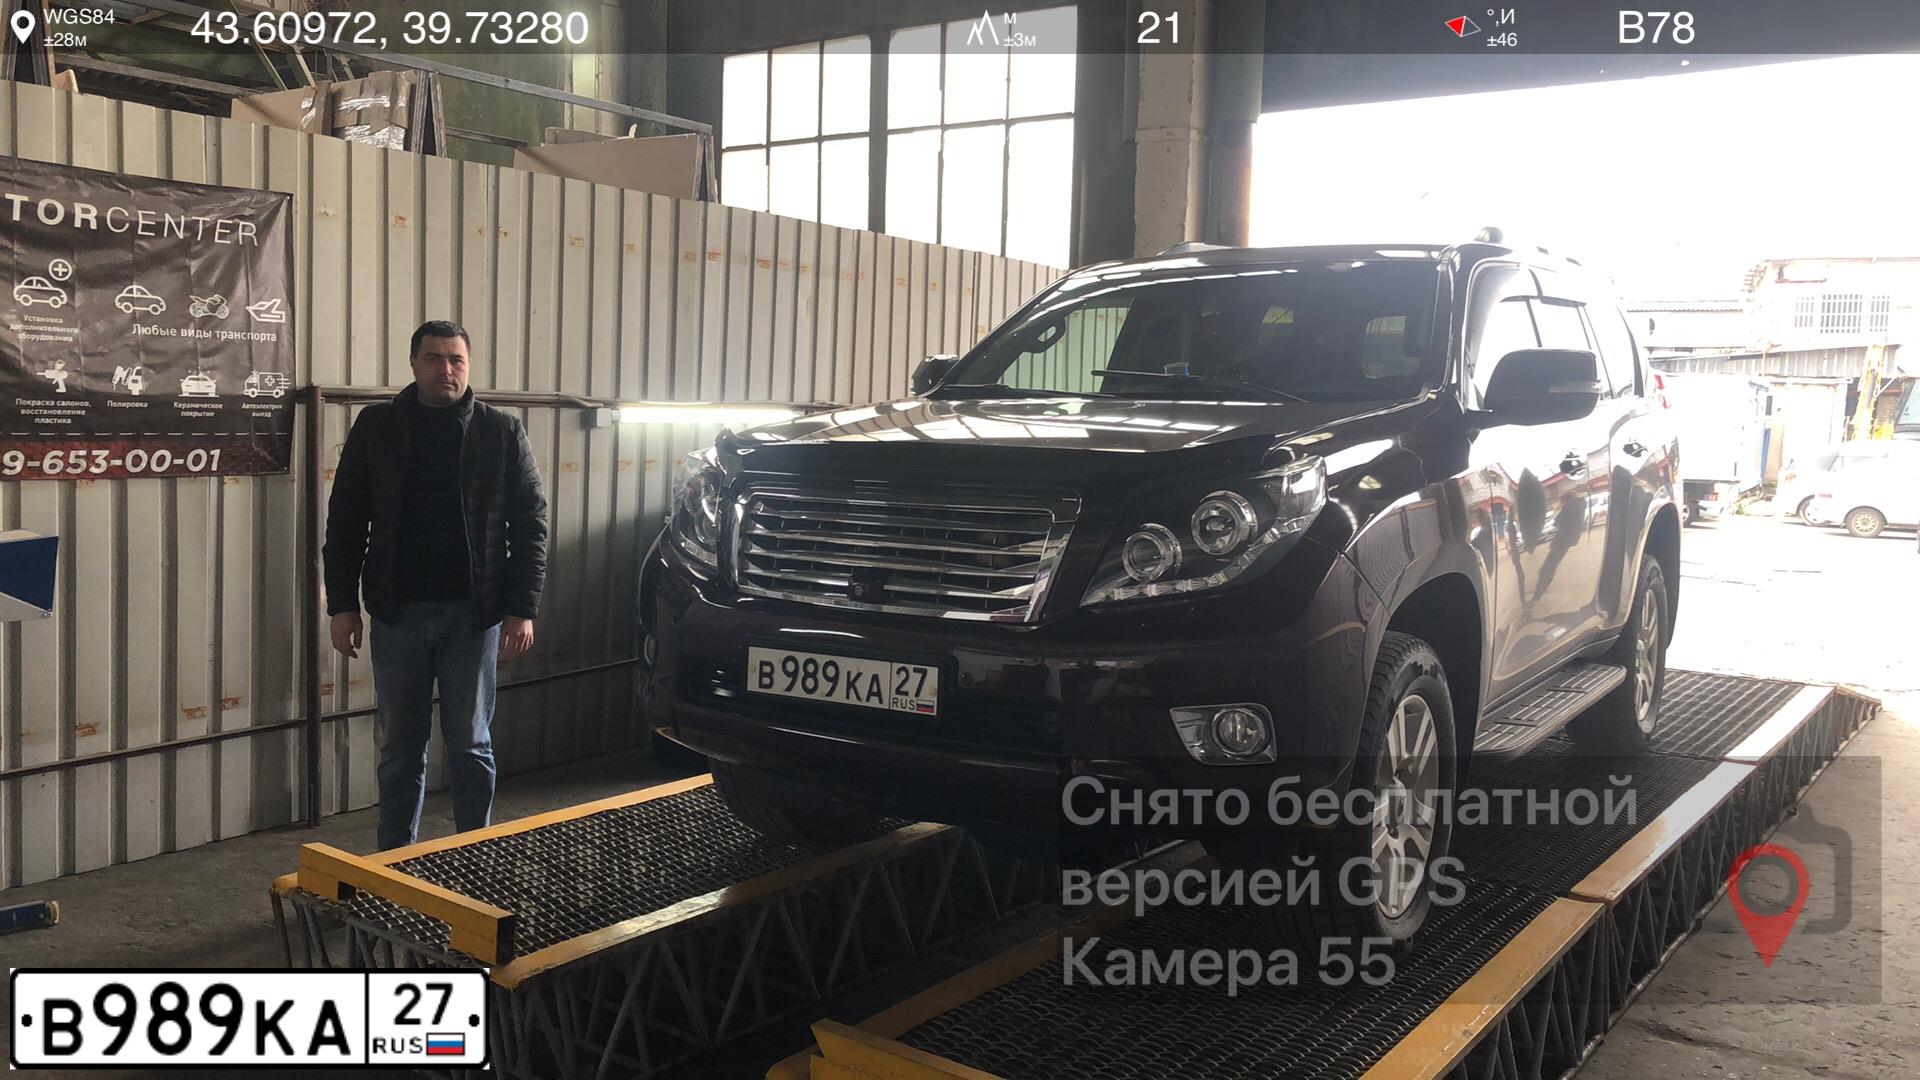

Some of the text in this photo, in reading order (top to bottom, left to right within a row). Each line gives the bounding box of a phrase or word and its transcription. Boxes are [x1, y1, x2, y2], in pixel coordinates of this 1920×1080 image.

[23, 314, 64, 324] Установка
[9, 323, 79, 334] дополнительного
[132, 323, 277, 343] Любые виды транспорта
[16, 332, 73, 342] оборудования
[15, 398, 55, 408] Покраска
[106, 399, 149, 409] Полировка
[173, 401, 223, 410] Керамическое
[20, 408, 86, 416] восстановление
[180, 410, 215, 418] покрытие
[34, 416, 72, 425] пластика
[894, 666, 928, 698] 27
[891, 697, 916, 711] RUS
